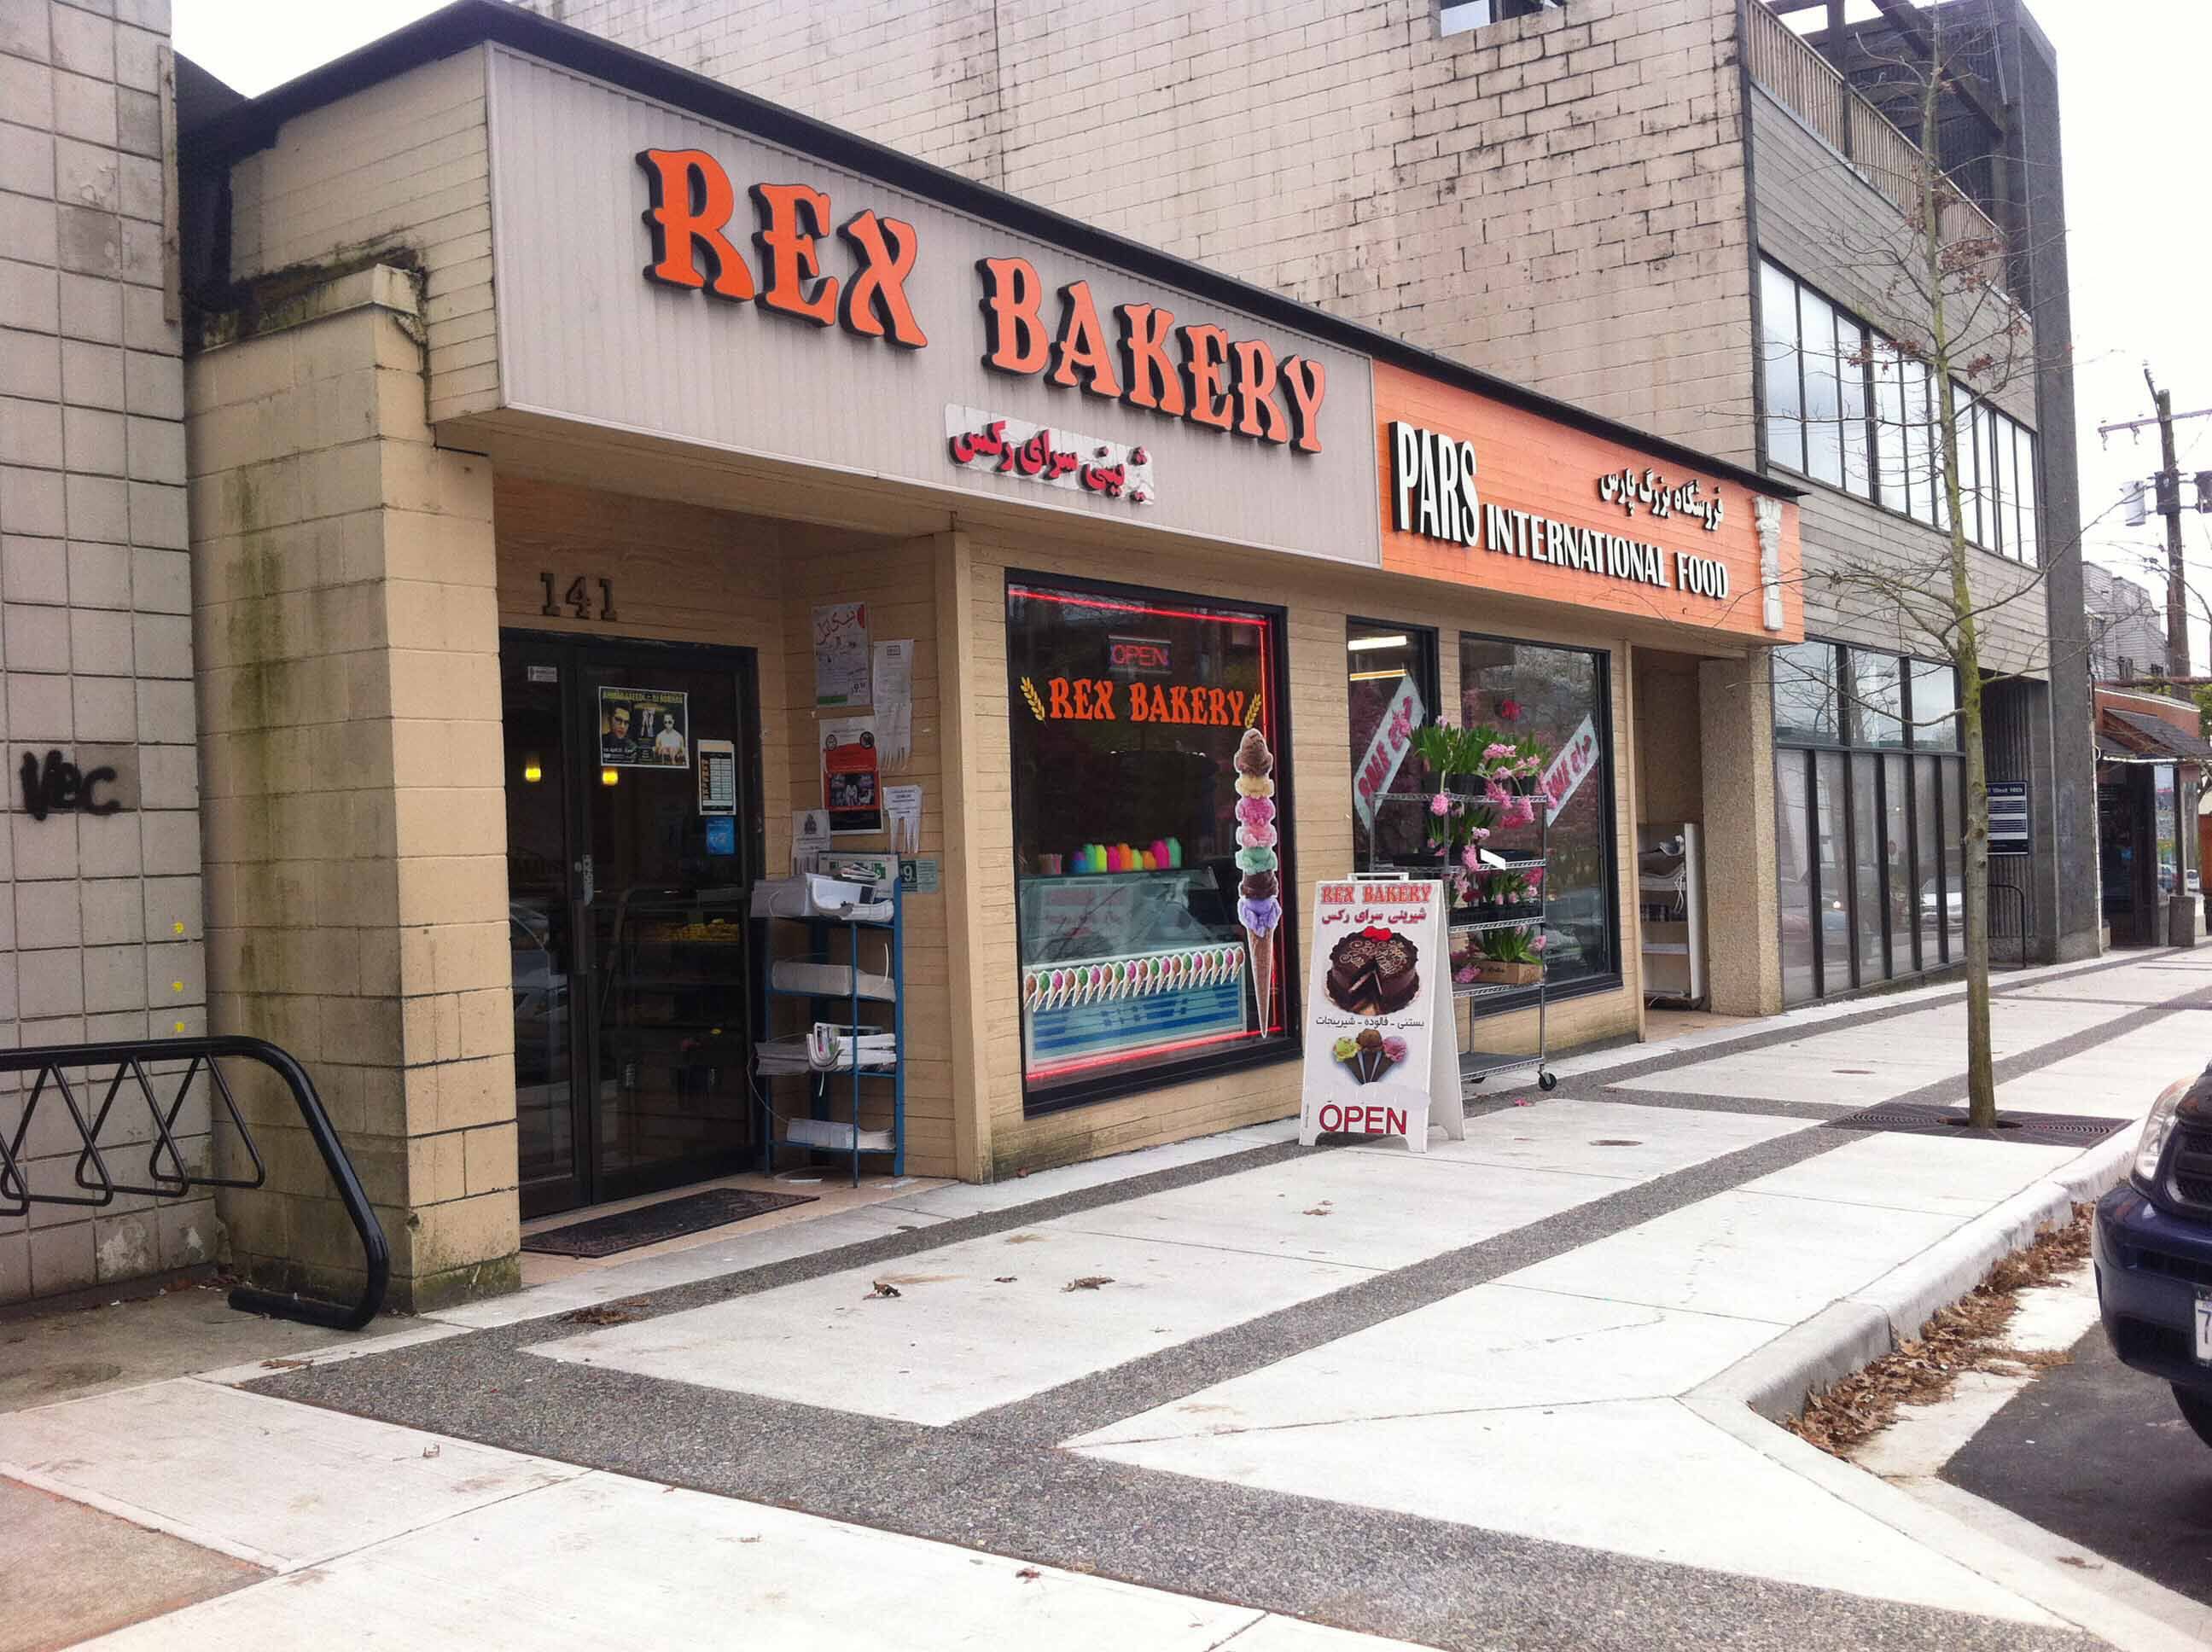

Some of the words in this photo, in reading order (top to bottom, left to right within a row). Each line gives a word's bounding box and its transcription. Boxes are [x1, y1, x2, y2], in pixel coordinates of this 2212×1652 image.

[635, 148, 928, 349] REX
[975, 257, 1325, 454] BAKERY
[1388, 420, 1479, 547] PARS
[1483, 503, 1670, 588] INTERNATIONAL
[1674, 551, 1729, 599] FOOD
[1598, 468, 1637, 516] پارس
[1637, 468, 1671, 518] بزرگ
[1673, 479, 1724, 531] فروشگاه
[540, 573, 617, 621] 141
[1112, 644, 1168, 666] OPEN
[1048, 677, 1116, 720] REX
[1129, 683, 1243, 726] BAKERY
[1321, 886, 1354, 905] REX
[1362, 883, 1433, 905] BAKERY
[1318, 1104, 1407, 1135] OPEN
